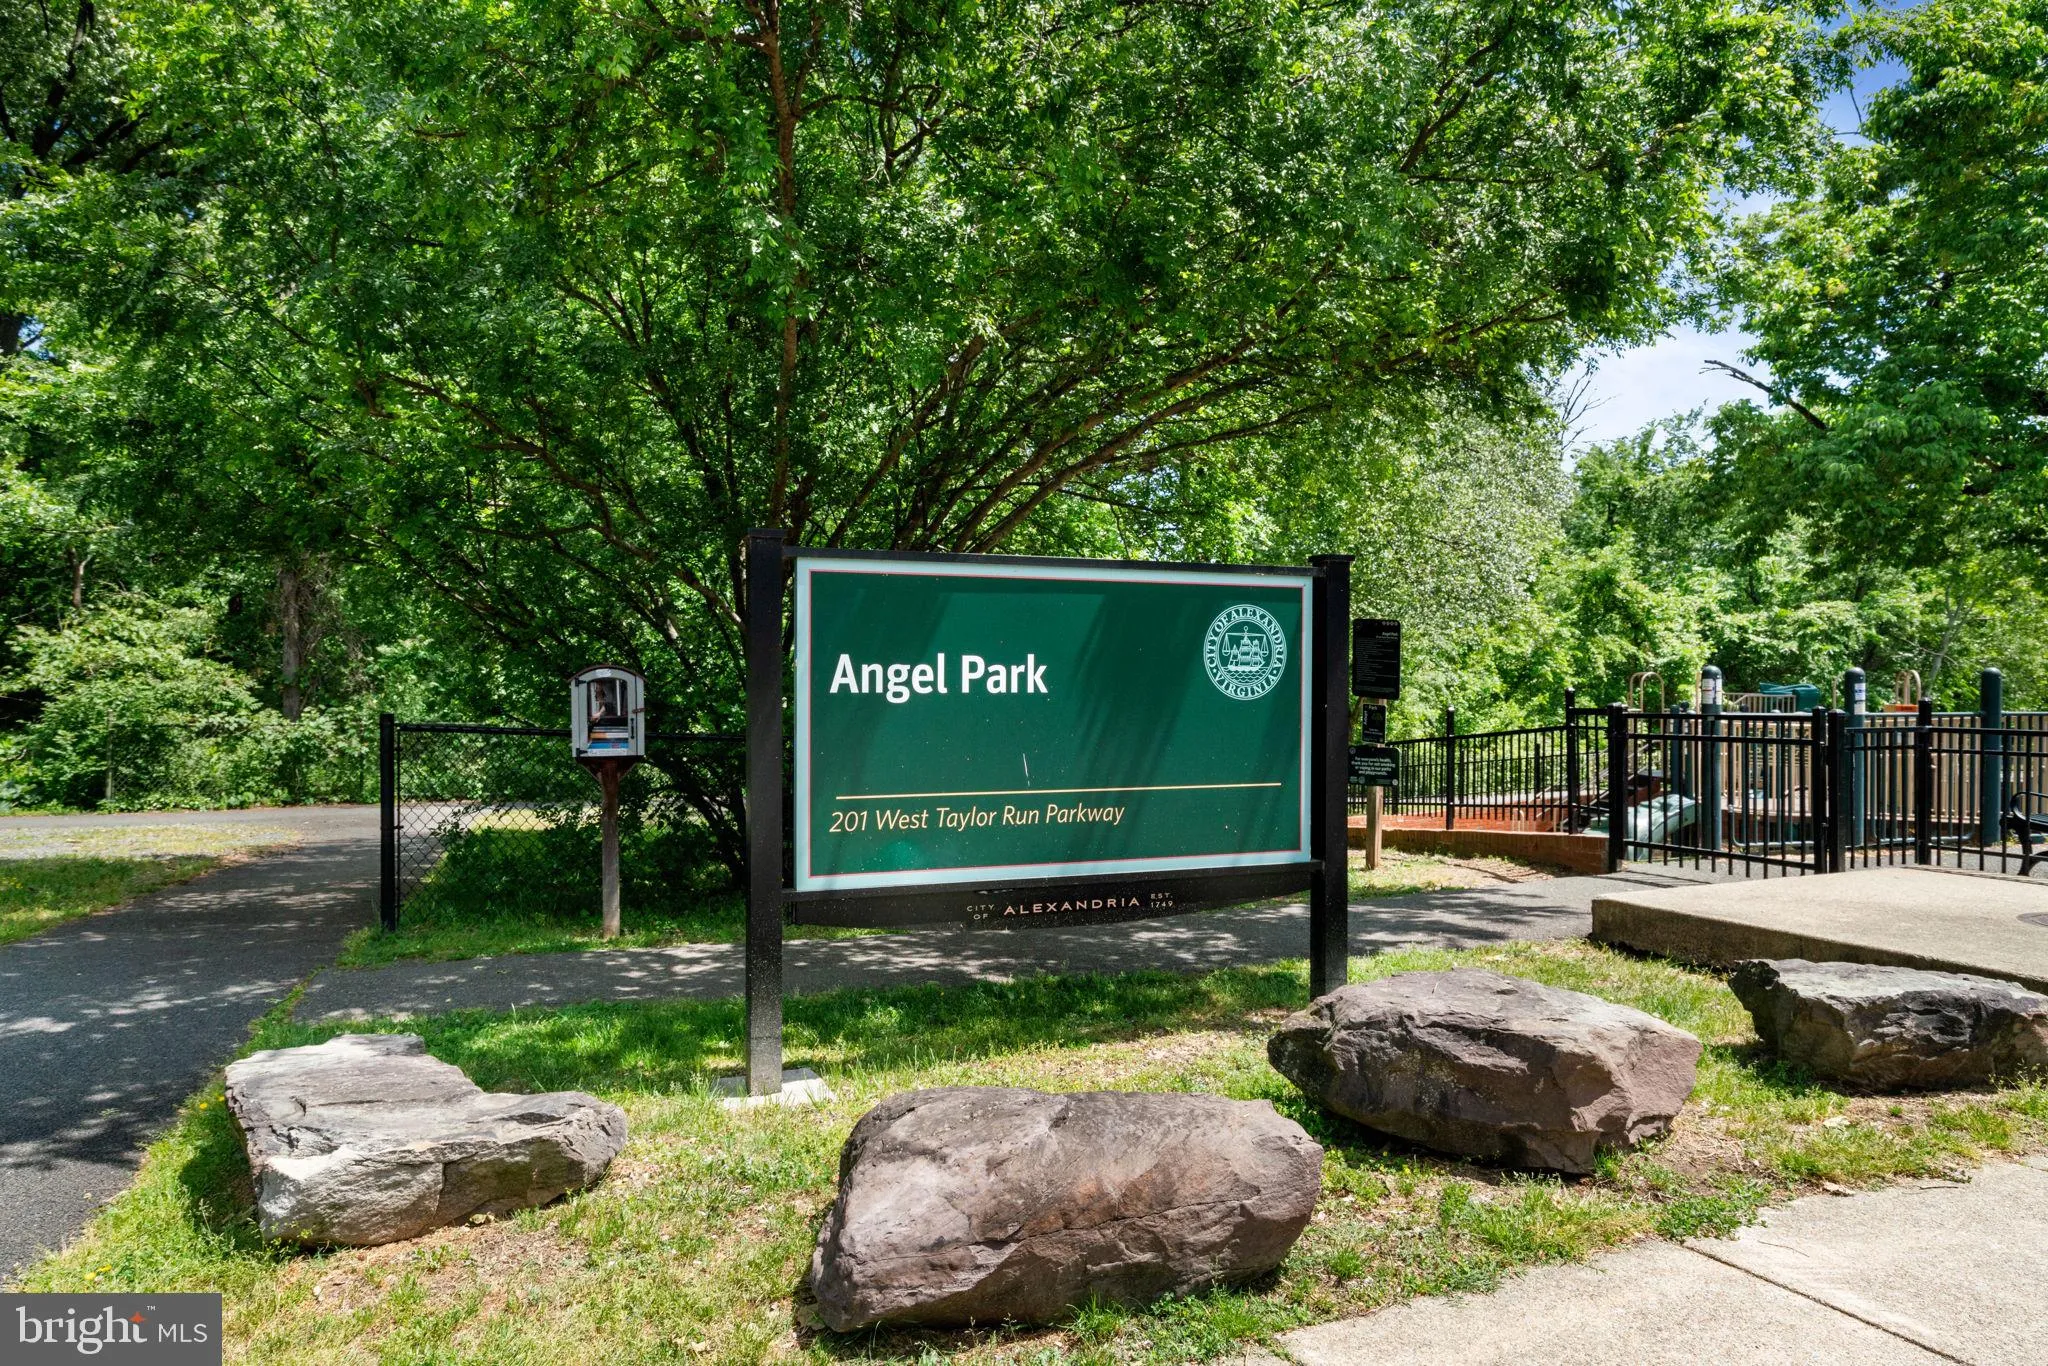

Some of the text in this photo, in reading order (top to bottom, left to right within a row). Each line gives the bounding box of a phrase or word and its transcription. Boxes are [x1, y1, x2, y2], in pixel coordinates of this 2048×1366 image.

[1207, 607, 1285, 668] CITY OF ALEXANDRIA
[829, 653, 1049, 704] Angel Park
[1215, 671, 1277, 697] VIRGINIA
[829, 803, 1125, 833] 201 West Taylor Run Parkway
[966, 904, 995, 912] CITY
[1003, 897, 1141, 916] ALEXANDRIA
[1150, 892, 1173, 900] EST.
